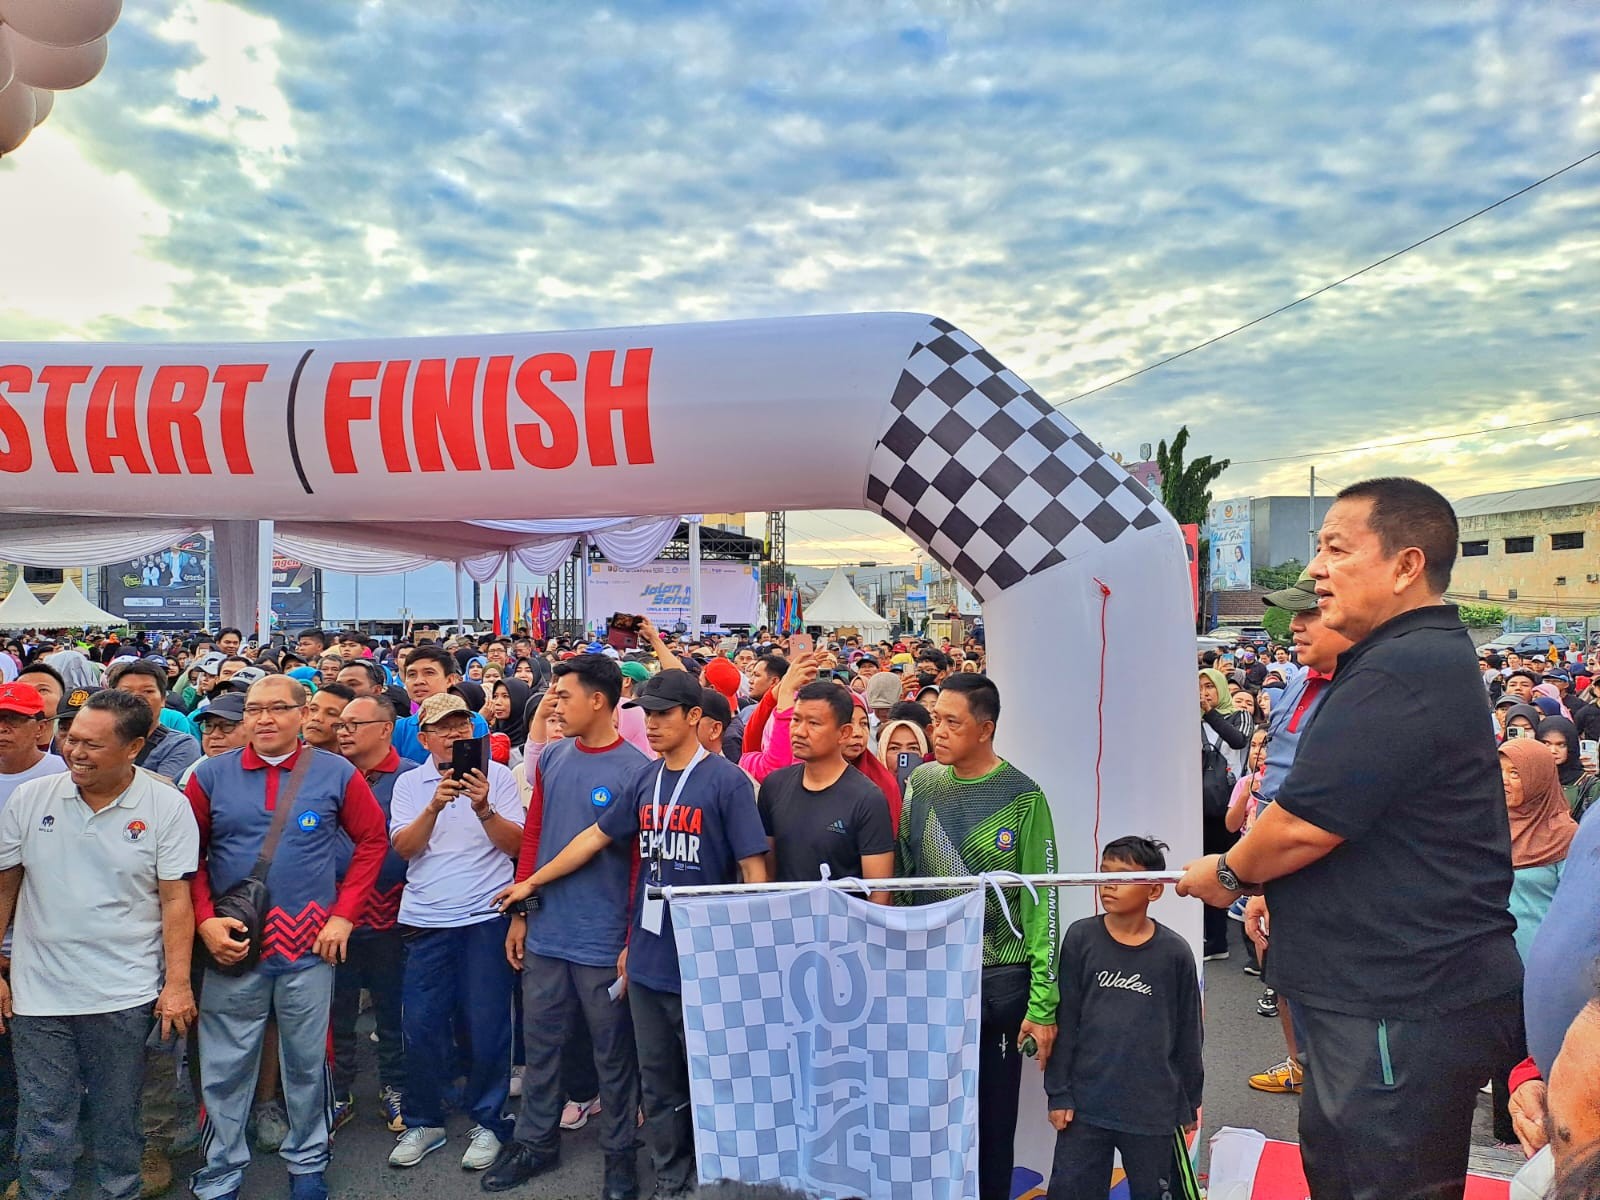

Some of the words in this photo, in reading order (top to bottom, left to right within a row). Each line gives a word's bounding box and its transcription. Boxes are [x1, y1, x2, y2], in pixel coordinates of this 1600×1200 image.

[324, 347, 655, 474] FINISH
[640, 583, 682, 596] Jalan
[652, 594, 692, 605] Seha
